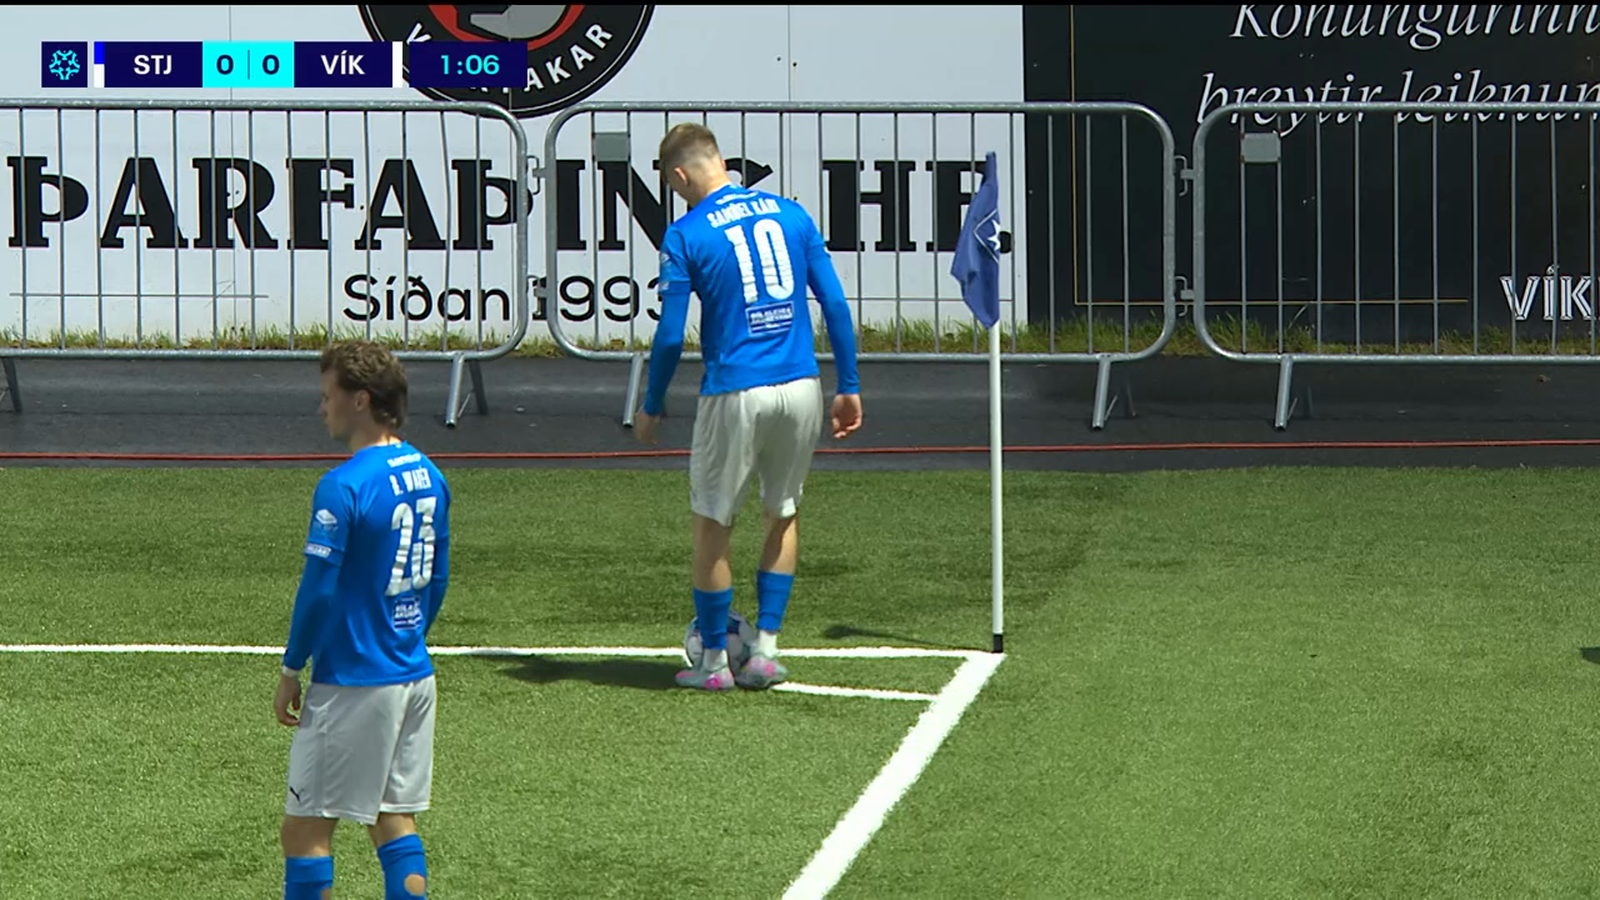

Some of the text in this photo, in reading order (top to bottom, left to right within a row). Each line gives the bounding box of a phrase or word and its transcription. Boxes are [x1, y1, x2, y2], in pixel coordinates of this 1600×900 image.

[343, 274, 511, 322] Síðan
[724, 218, 795, 304] 10
[384, 496, 437, 597] 23
